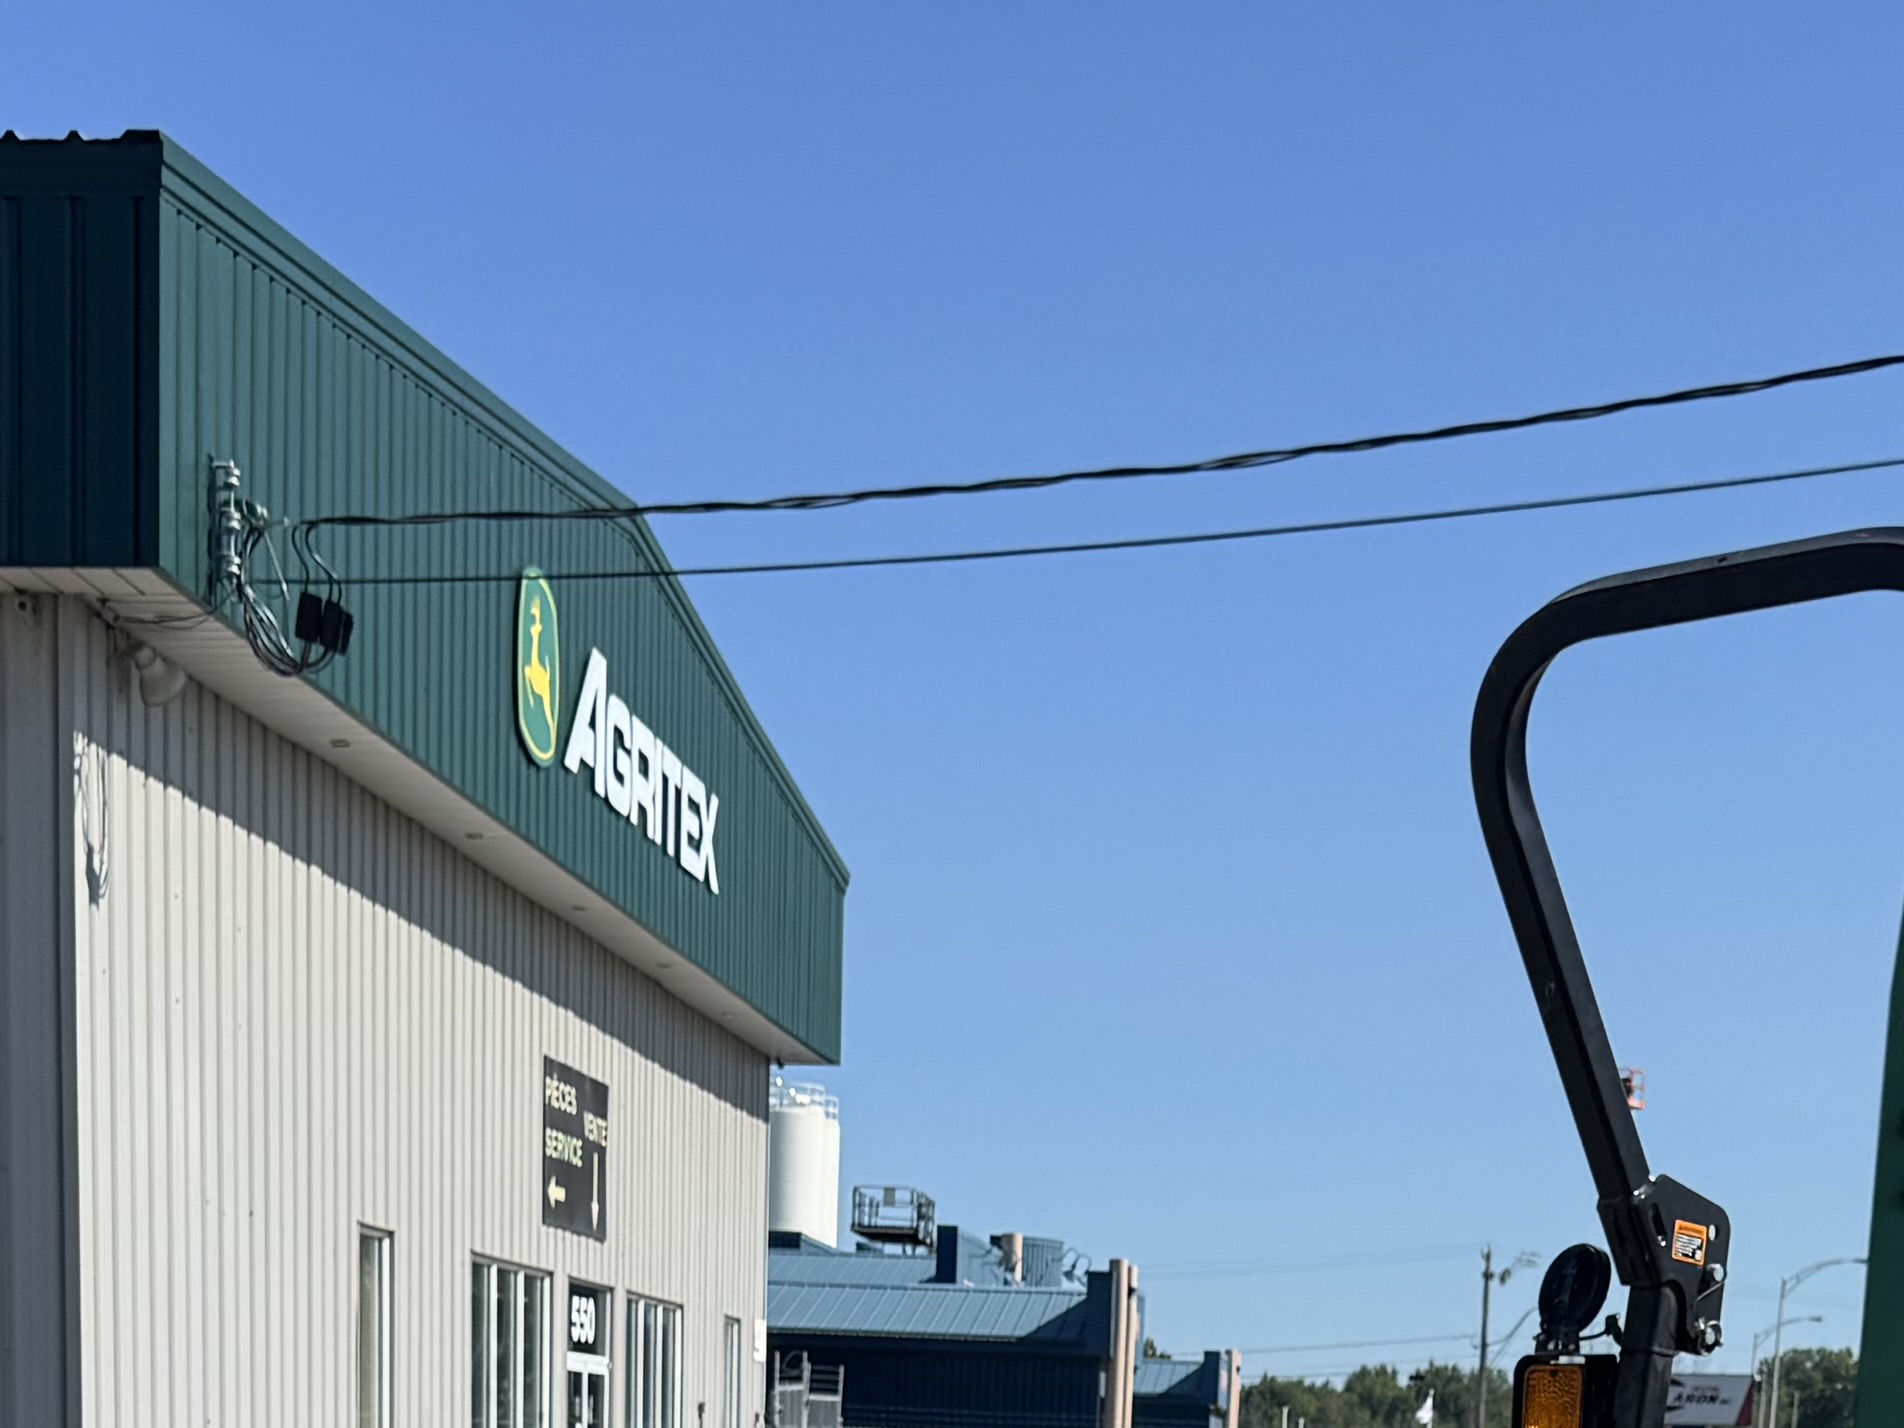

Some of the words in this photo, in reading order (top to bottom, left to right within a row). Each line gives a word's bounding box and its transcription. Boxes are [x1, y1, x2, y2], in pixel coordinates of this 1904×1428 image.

[564, 646, 719, 895] AGRITEX
[545, 1127, 583, 1168] SERVICE
[571, 1295, 596, 1345] 550
